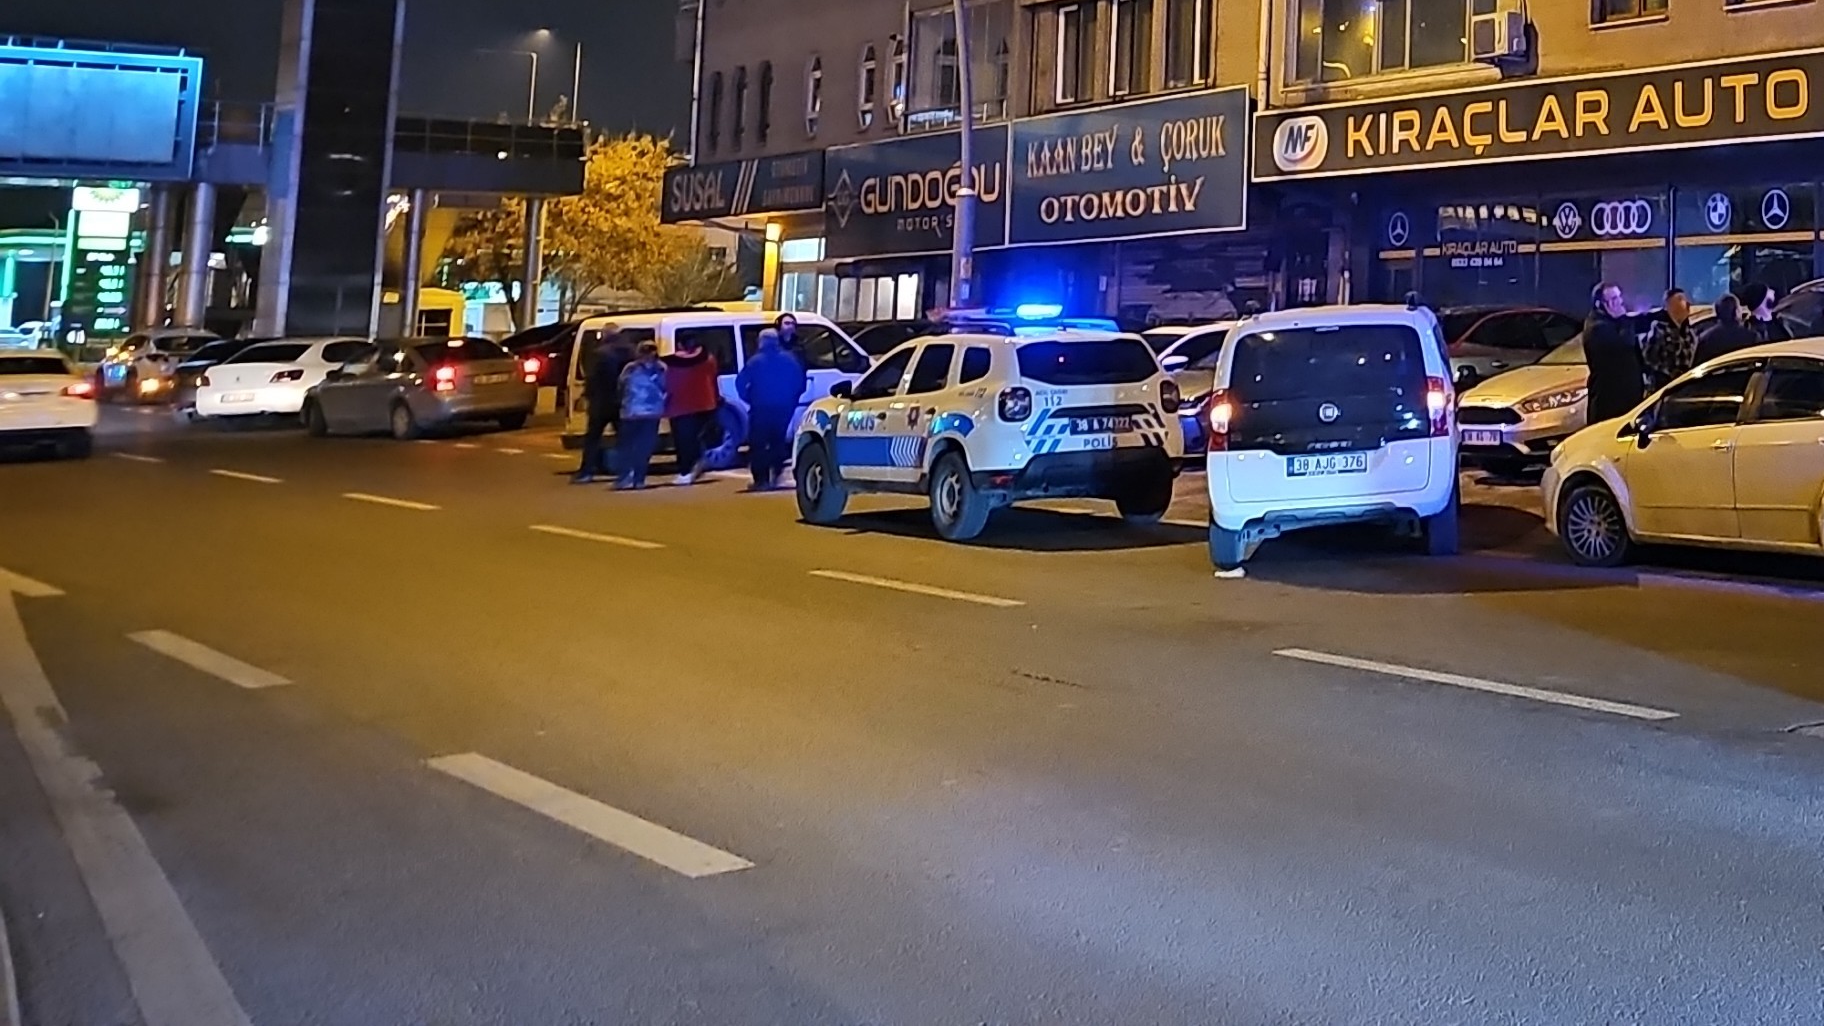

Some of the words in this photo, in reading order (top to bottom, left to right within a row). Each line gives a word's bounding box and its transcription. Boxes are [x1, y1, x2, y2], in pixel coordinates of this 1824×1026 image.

[1346, 90, 1611, 157] KIRAÇLAR
[1628, 69, 1810, 133] AUTO
[1027, 136, 1078, 178] KAAN
[1081, 124, 1119, 172] BEY
[1130, 126, 1146, 166] &
[1160, 115, 1226, 173] ÇORUK
[671, 170, 725, 213] SUSAL
[860, 160, 1001, 215] GUNDOĞU
[1040, 175, 1205, 224] OTOMOTİV
[1489, 240, 1517, 255] AUTO
[1044, 395, 1062, 407] 112
[1083, 435, 1118, 448] POLİS
